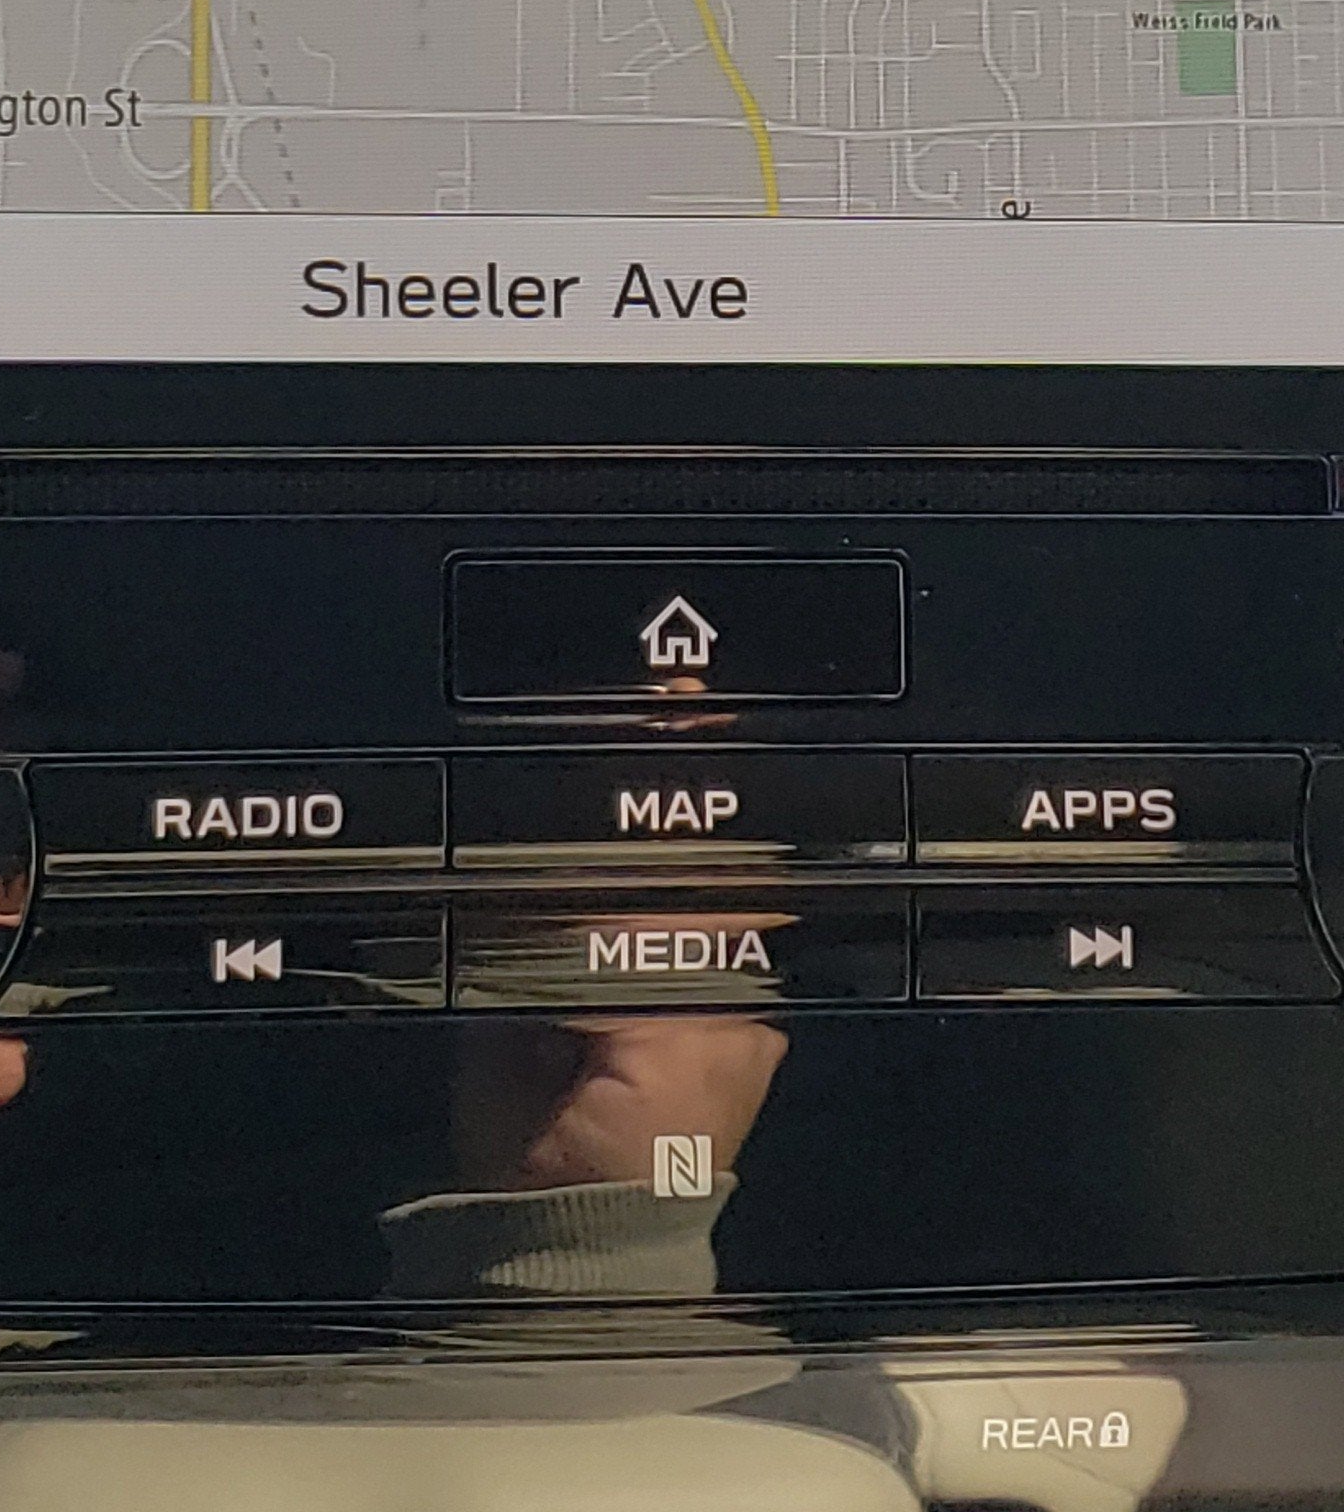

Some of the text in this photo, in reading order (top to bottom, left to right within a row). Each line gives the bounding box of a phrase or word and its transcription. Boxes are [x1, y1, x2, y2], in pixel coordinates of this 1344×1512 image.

[1243, 14, 1283, 31] Park
[104, 87, 143, 127] St
[300, 258, 749, 320] Sheeler Ave
[153, 793, 344, 840] RADIO
[618, 789, 739, 832] MAP
[1021, 788, 1177, 831] APPS
[587, 928, 772, 974] MEDIA
[981, 1416, 1093, 1450] REAR
